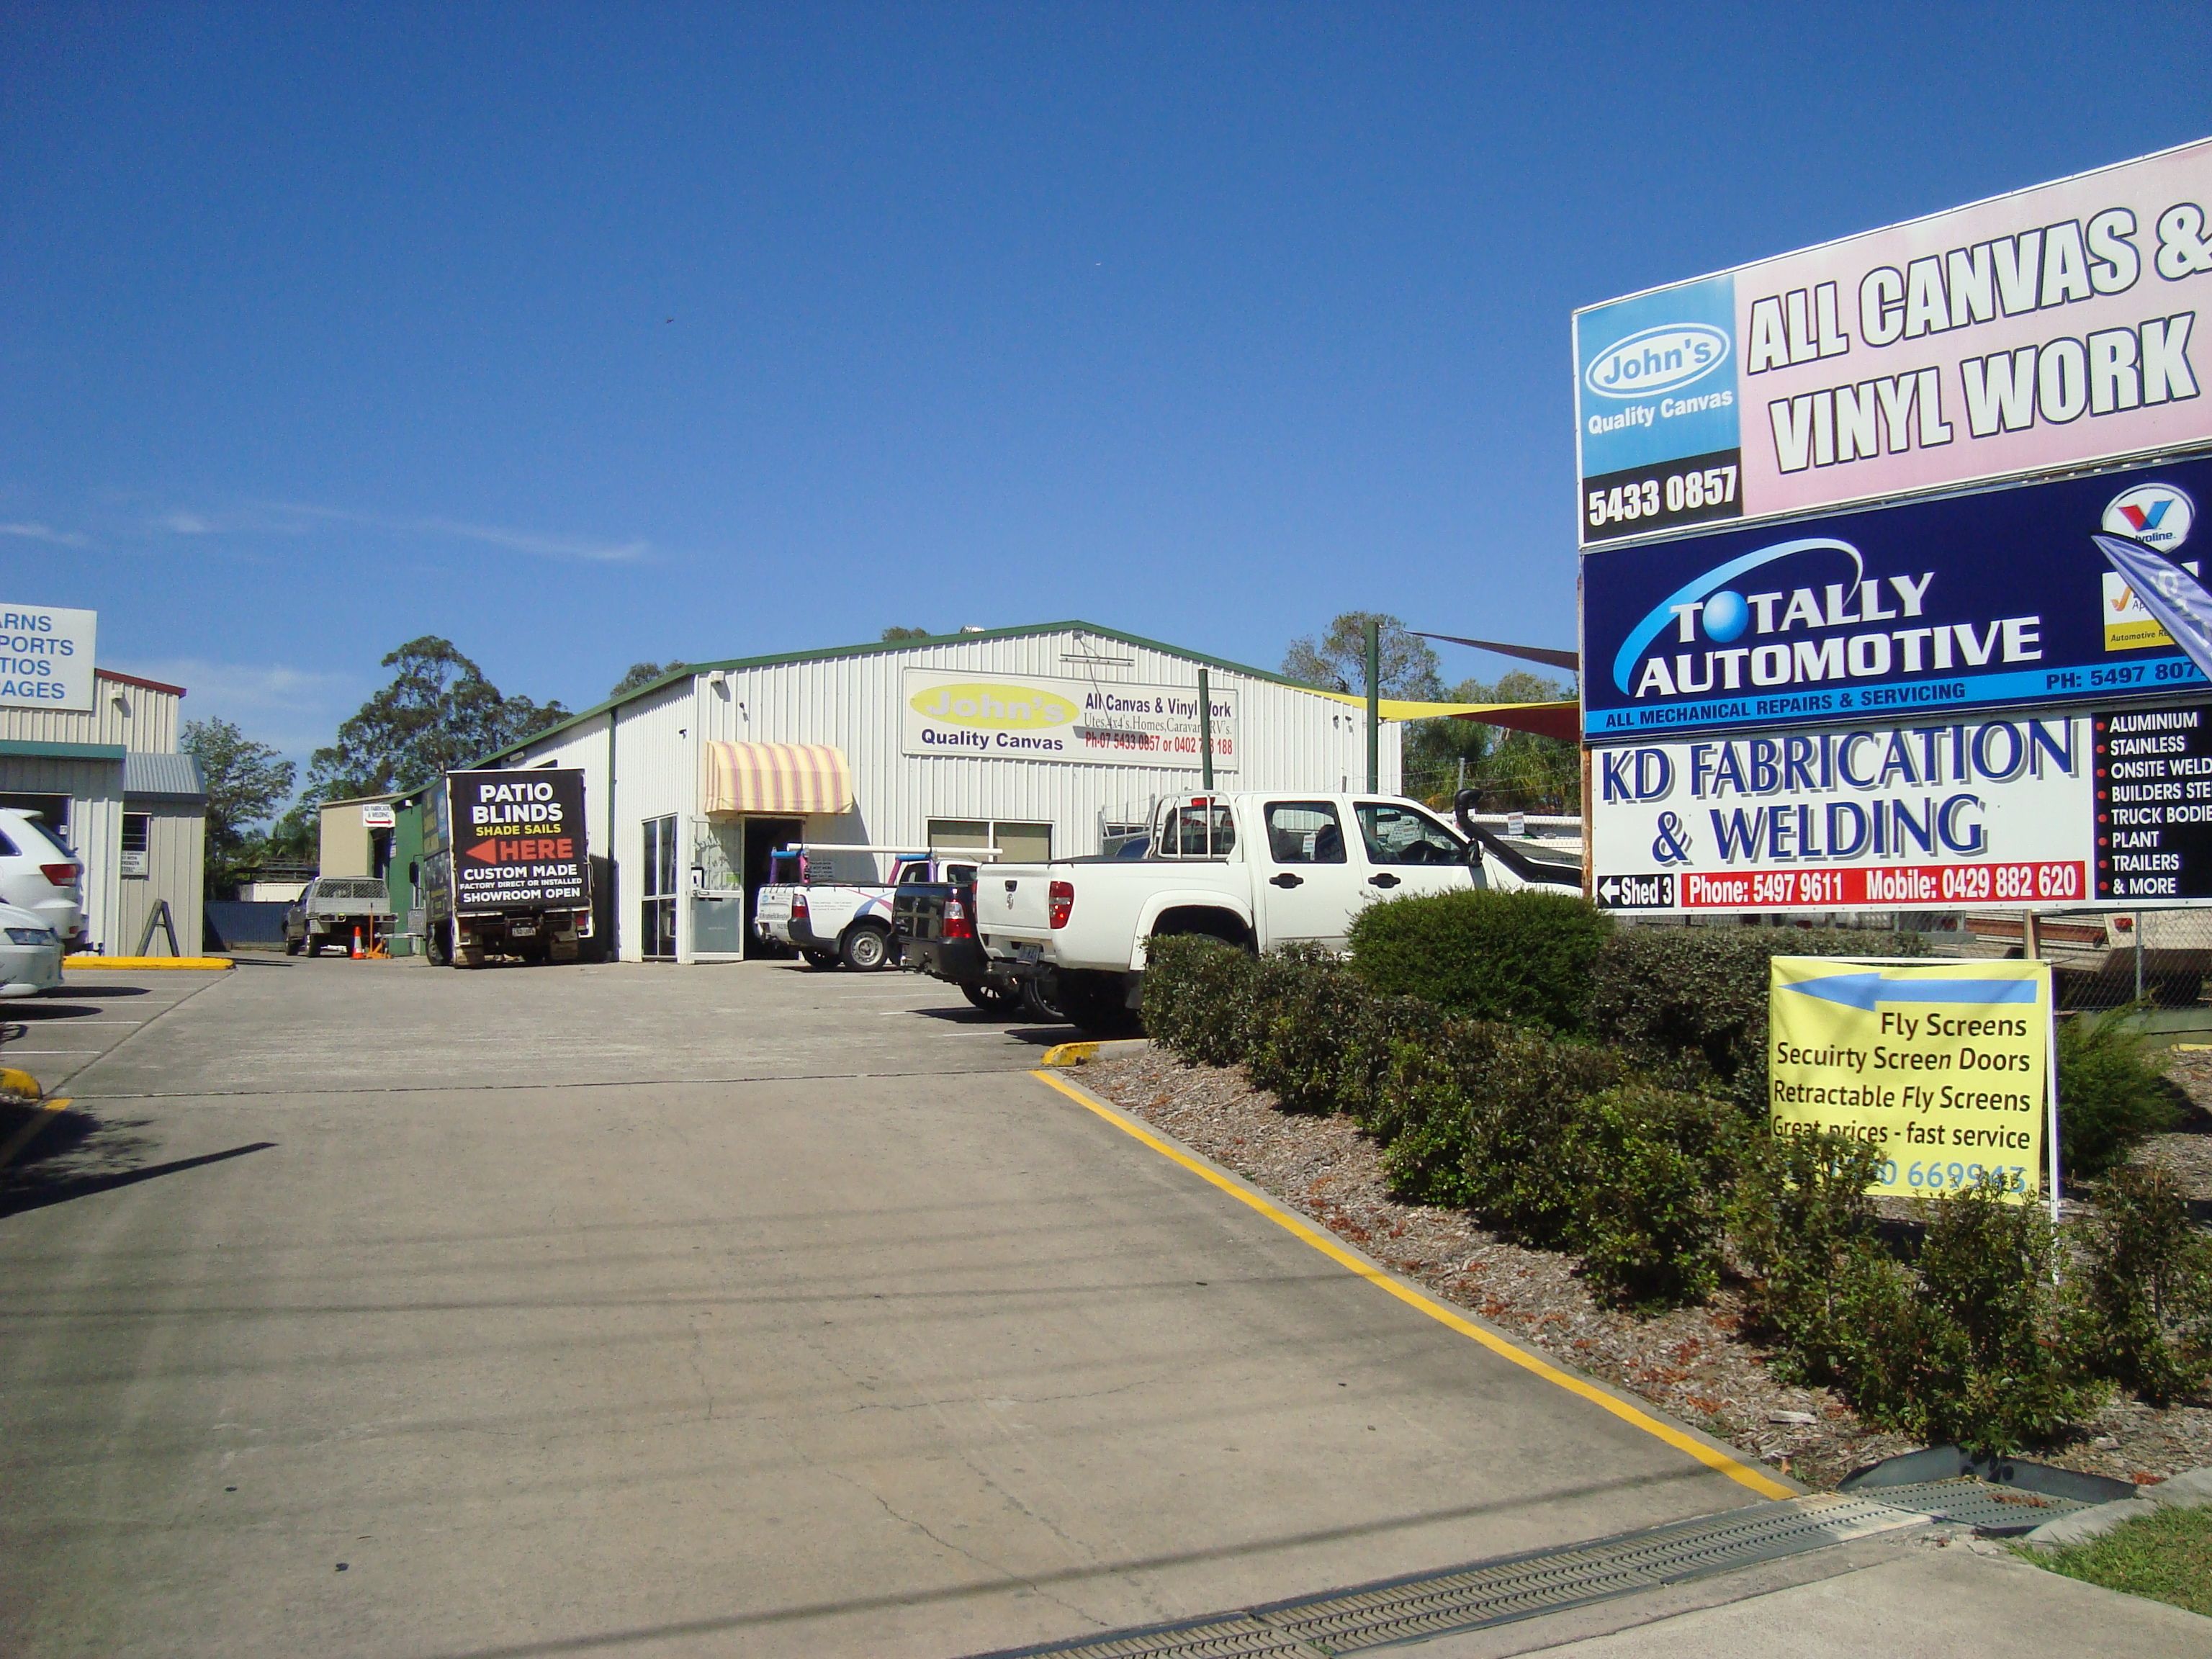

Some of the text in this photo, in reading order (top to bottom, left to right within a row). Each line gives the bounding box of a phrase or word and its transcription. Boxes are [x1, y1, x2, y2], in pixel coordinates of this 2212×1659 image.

[1748, 202, 2212, 375] ALL CANVAS &
[1604, 339, 1712, 385] John's
[1768, 311, 2200, 474] VINYL WORK
[1588, 390, 1733, 434] Quality Canvas
[1588, 465, 1737, 526] 5433 0857
[1671, 571, 1936, 644] TOTALLY
[2110, 631, 2155, 642] Automotive
[0, 657, 51, 676] TIOS
[1635, 616, 2042, 698] AUTOMOTIVE
[2046, 661, 2208, 691] PH: 5497 807
[1, 680, 65, 699] AGES
[925, 691, 1064, 723] John's
[1085, 693, 1231, 719] All Canvas & Vinyl ork
[1605, 683, 1966, 728] ALL MECHANICAL REPAIRS & SERVICING
[2109, 711, 2198, 733] ALUMINIUM
[922, 729, 1064, 750] Quality Canvas
[1114, 733, 1136, 750] 5433
[1138, 734, 1159, 751] 0857
[1163, 739, 1172, 752] or
[1174, 736, 1196, 753] 0402
[1217, 738, 1232, 755] 188
[2110, 735, 2185, 756] STAINLESS
[1602, 716, 2079, 805] KD FABRICATION
[2110, 757, 2212, 779] ONSITE WELD
[480, 783, 554, 803] PATIO
[2112, 781, 2212, 803] BUILDERS STE
[472, 803, 563, 824] BLINDS
[2111, 806, 2162, 825] TRUCK
[476, 824, 561, 836] SHADE SAILS
[1653, 793, 1988, 866] & WELDING
[2112, 831, 2159, 848] PLANT
[500, 838, 573, 861] HERE
[464, 864, 577, 881] CUSTOM MADE
[2112, 854, 2180, 872] TRAILERS
[460, 881, 495, 890] FACTORY
[541, 877, 582, 886] INSTALLED
[463, 887, 580, 903] SHOWROOM OPEN
[1621, 876, 1672, 904] Shed 3
[1689, 865, 2076, 904] Phone: 5497 9611 Mobile: 0429 882 620
[2113, 877, 2176, 895] & MORE
[1881, 1012, 2027, 1041] Fly Screens
[1777, 1042, 2031, 1074] Secuirty Screen Doors
[1774, 1080, 2031, 1114] Retractable Fly Screens
[1907, 1120, 1945, 1145] fast
[1952, 1124, 2031, 1150] service
